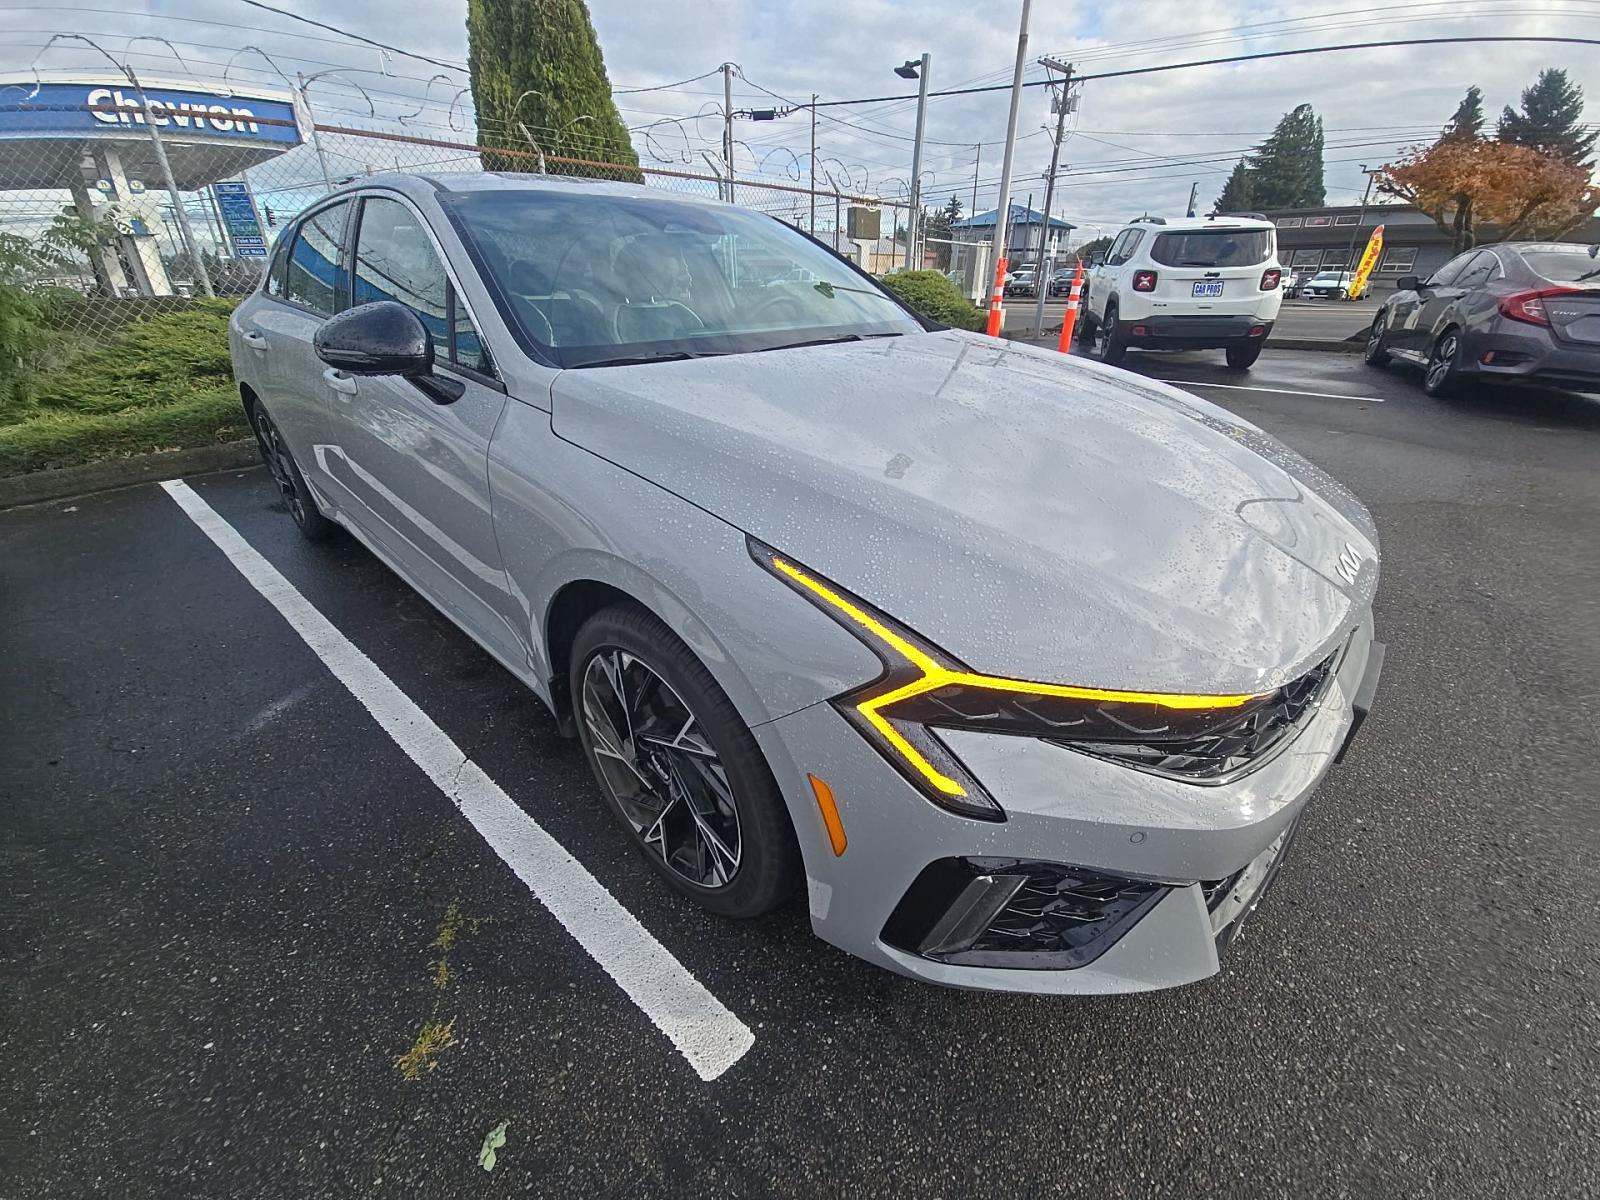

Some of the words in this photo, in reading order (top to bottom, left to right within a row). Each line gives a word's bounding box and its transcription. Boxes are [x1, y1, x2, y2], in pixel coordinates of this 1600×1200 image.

[88, 89, 259, 133] Chevron
[1195, 284, 1206, 294] CAR
[1206, 284, 1221, 294] PROS
